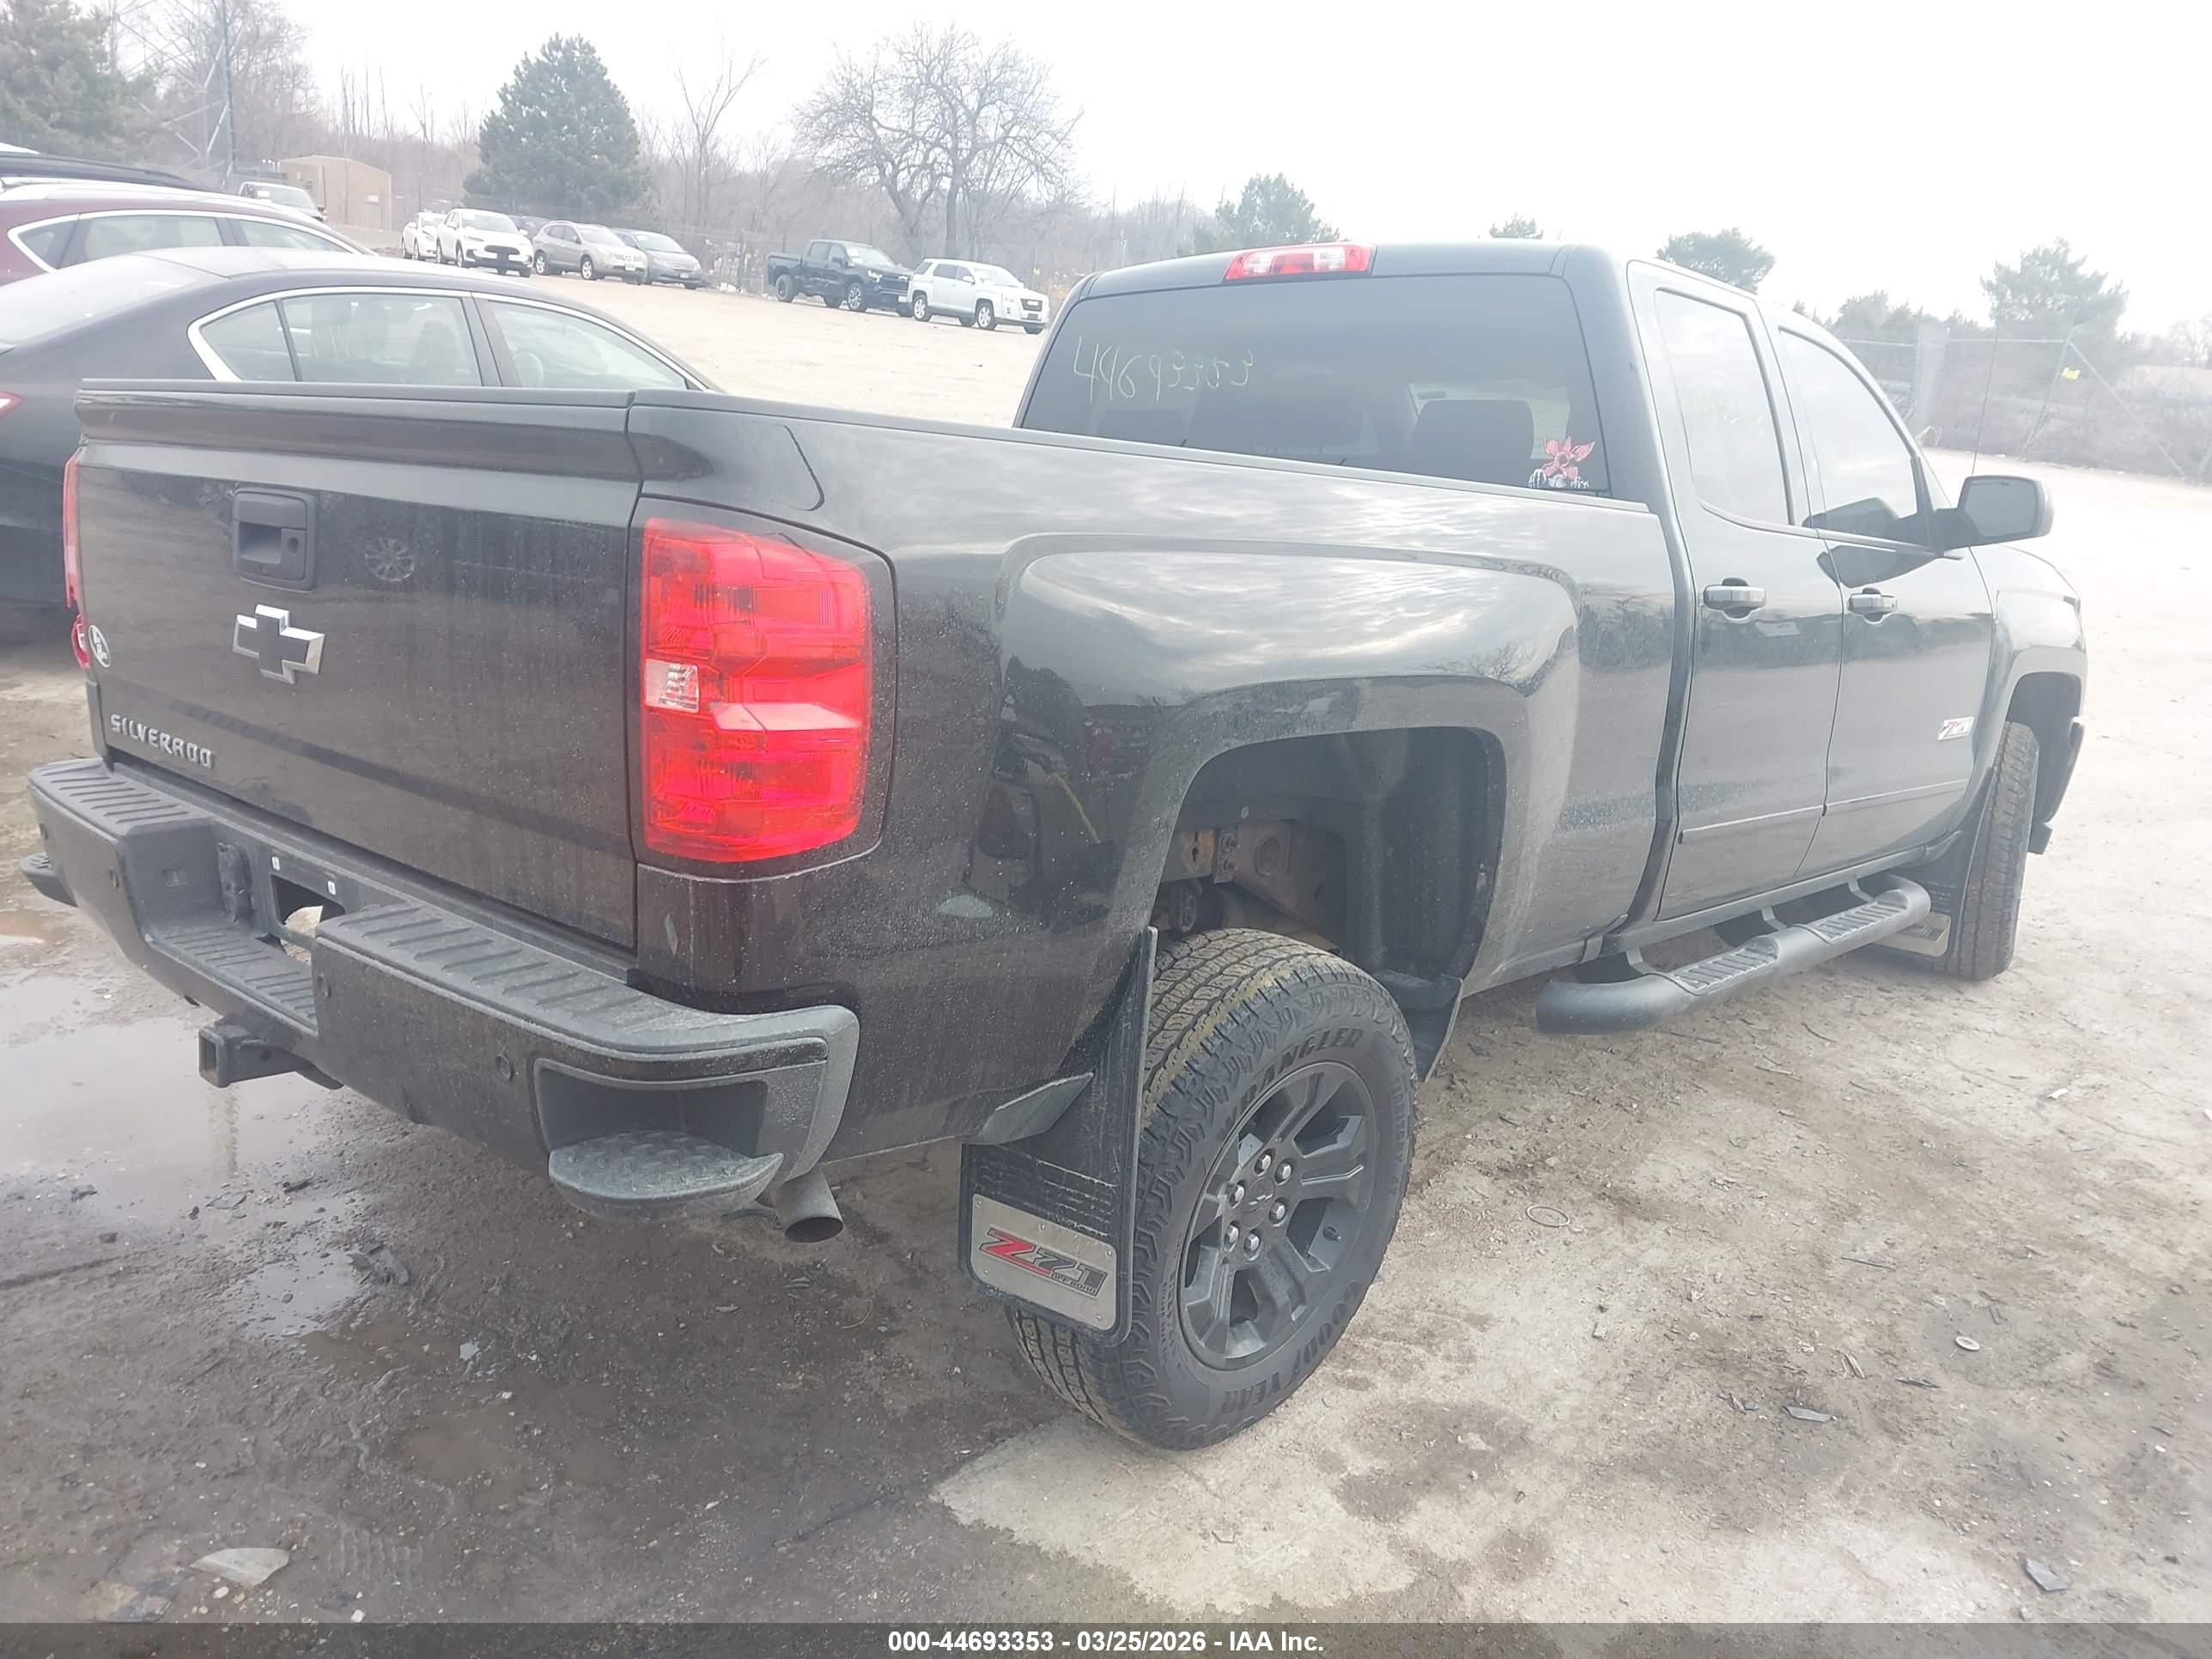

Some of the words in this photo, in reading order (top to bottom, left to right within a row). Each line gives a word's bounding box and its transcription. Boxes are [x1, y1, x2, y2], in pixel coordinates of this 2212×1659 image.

[109, 714, 213, 769] SILVERADO
[979, 1227, 1108, 1294] Z71
[1219, 1280, 1363, 1414] GOODYEAR
